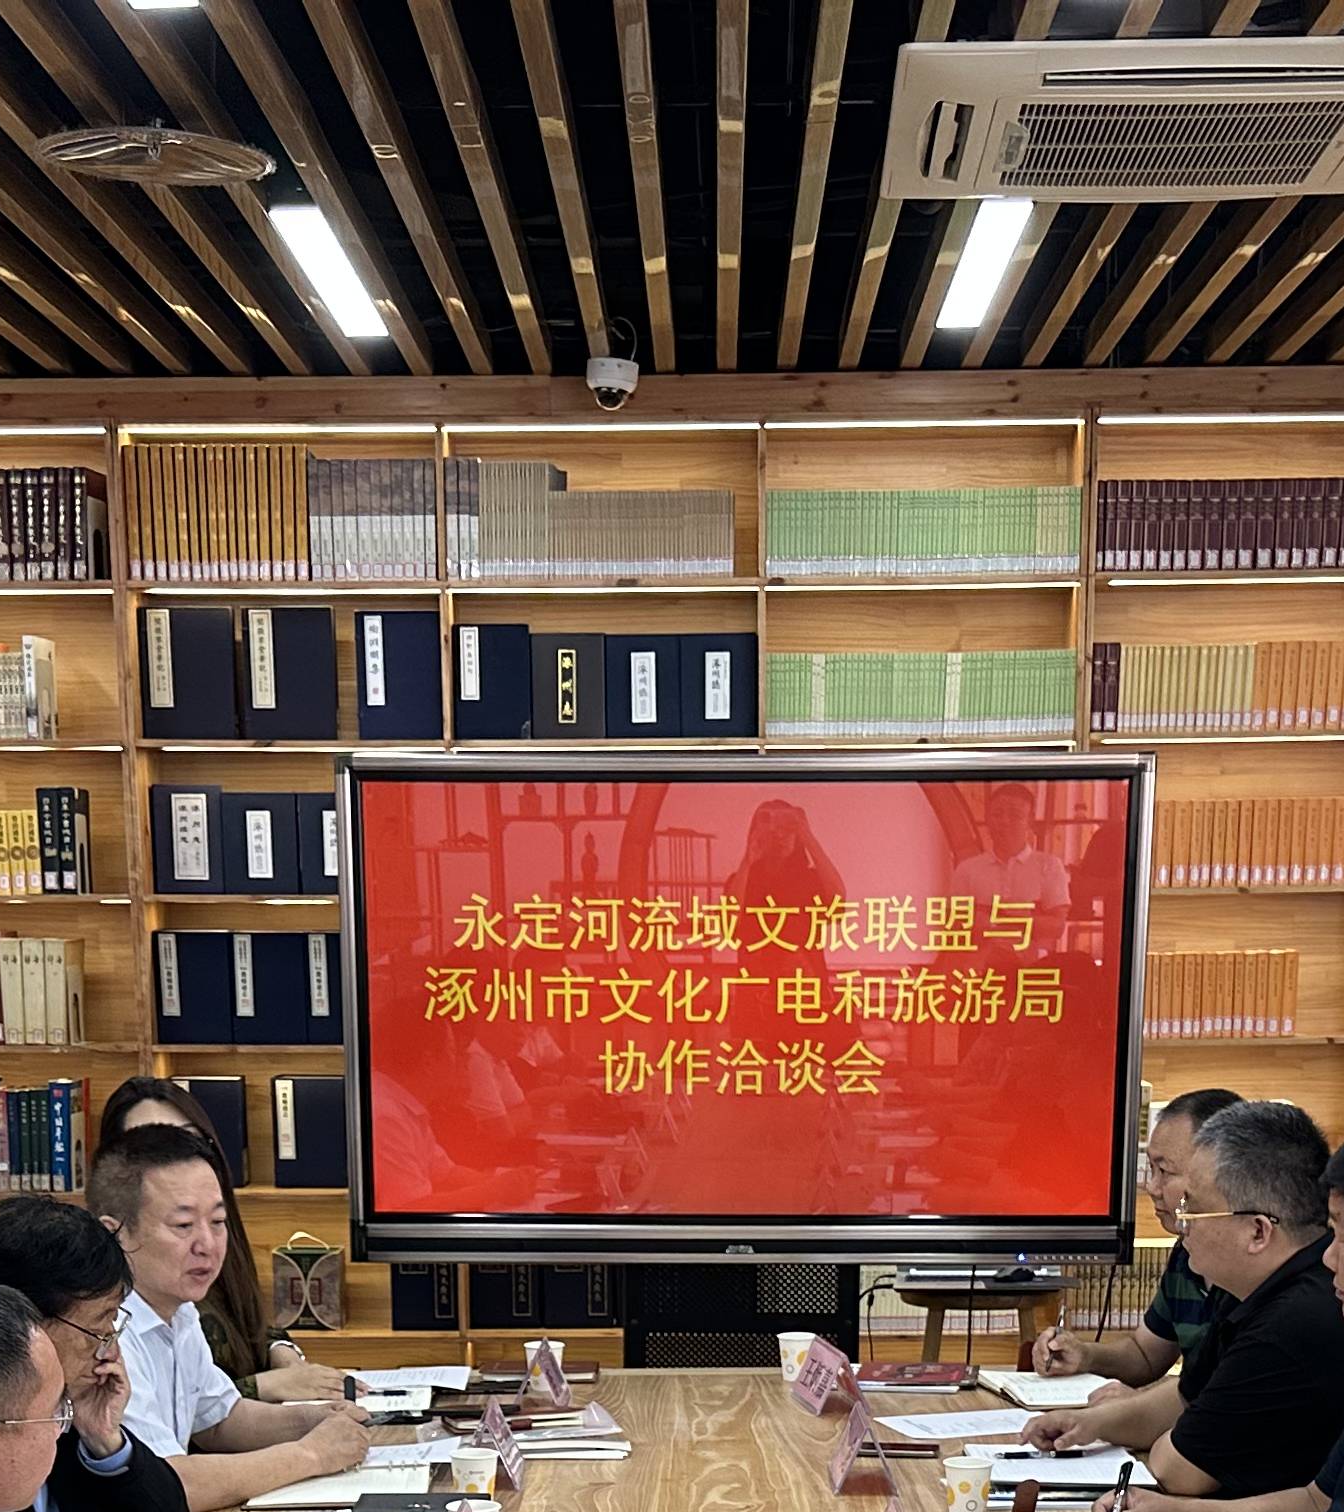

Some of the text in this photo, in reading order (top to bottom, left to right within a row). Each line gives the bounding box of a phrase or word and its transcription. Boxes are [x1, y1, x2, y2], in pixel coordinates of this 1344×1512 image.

[453, 895, 1034, 952] 永定河流域文旅联盟与
[424, 967, 1064, 1024] 涿州市文化广电和旅游局
[599, 1040, 885, 1095] 协作洽谈会
